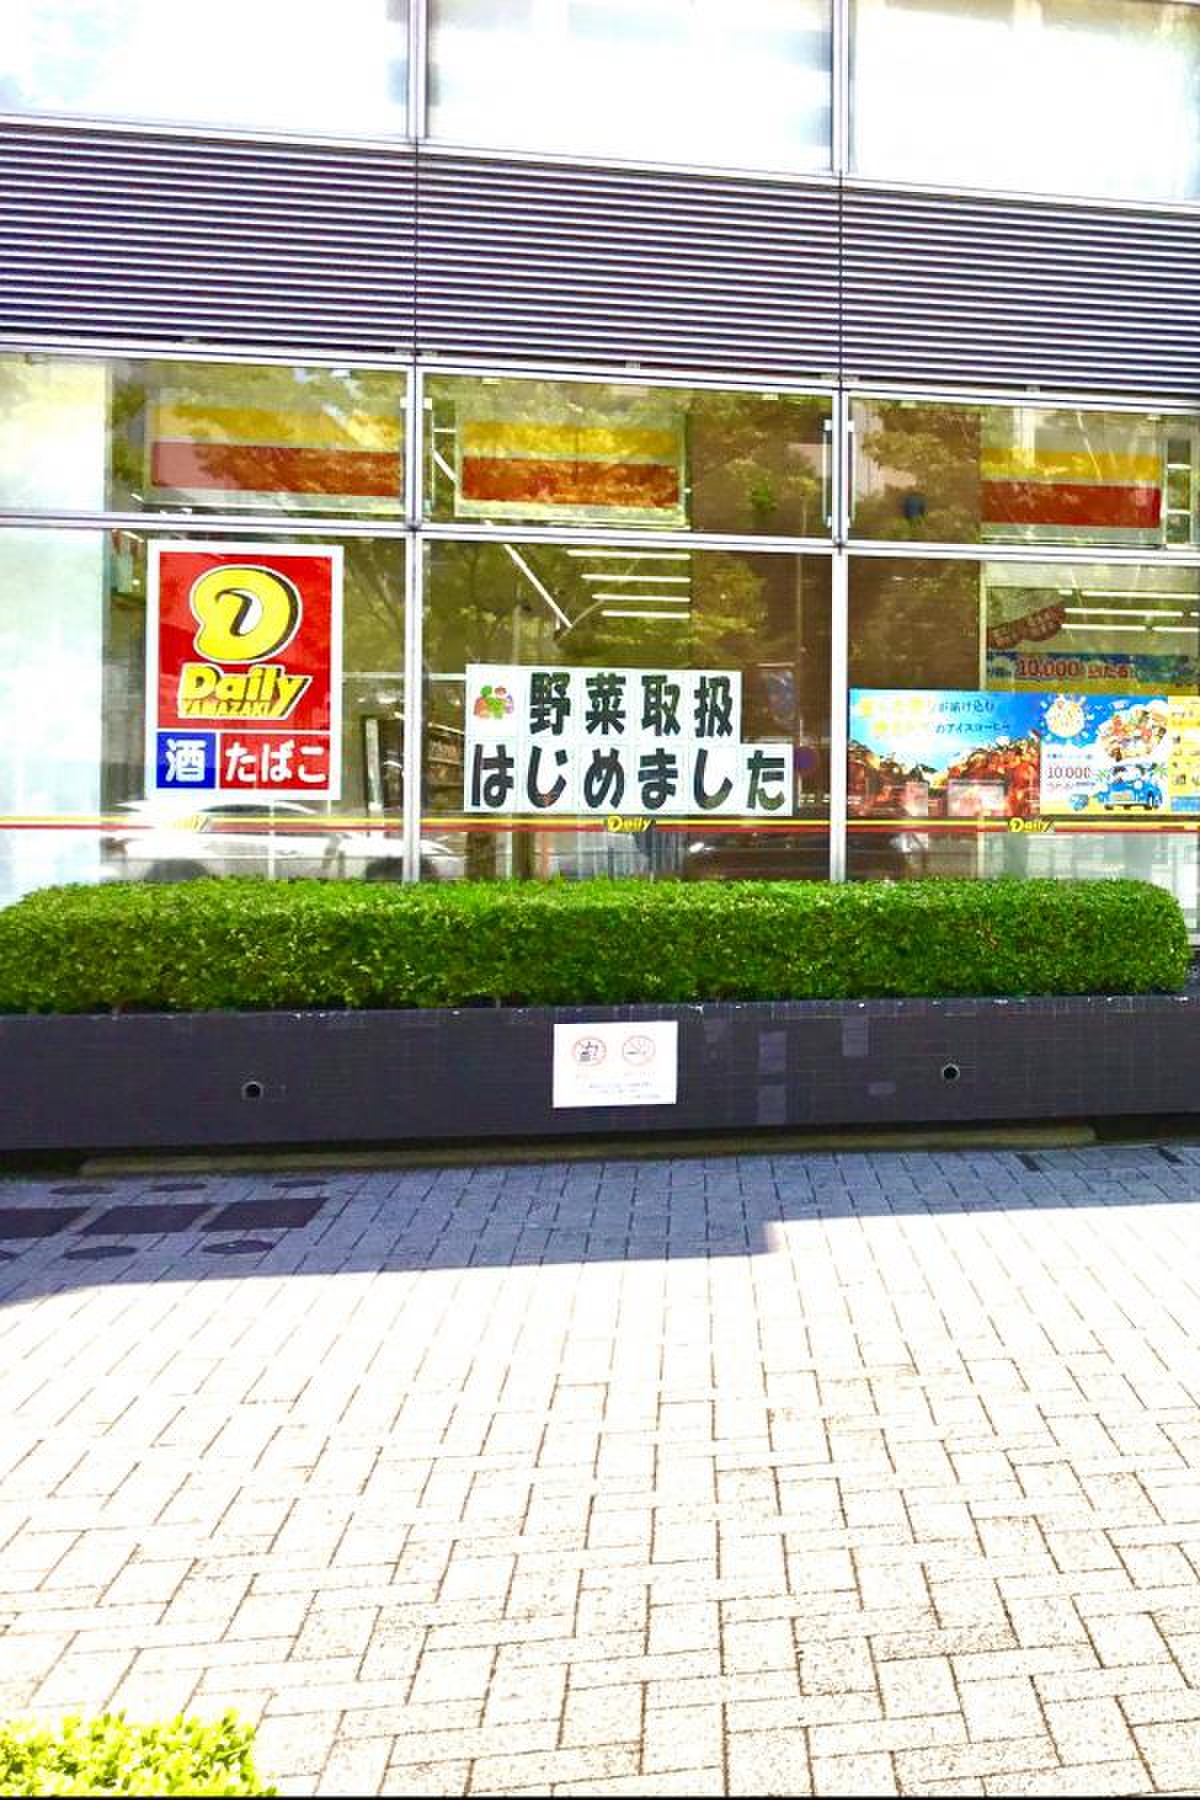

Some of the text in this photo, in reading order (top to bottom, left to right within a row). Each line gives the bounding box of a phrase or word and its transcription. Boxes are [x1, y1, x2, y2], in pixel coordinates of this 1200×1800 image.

[178, 664, 312, 718] Daily
[529, 671, 734, 738] 野菜取扱
[165, 738, 206, 783] 酒
[224, 738, 327, 784] たばこ
[470, 743, 787, 811] はじめました
